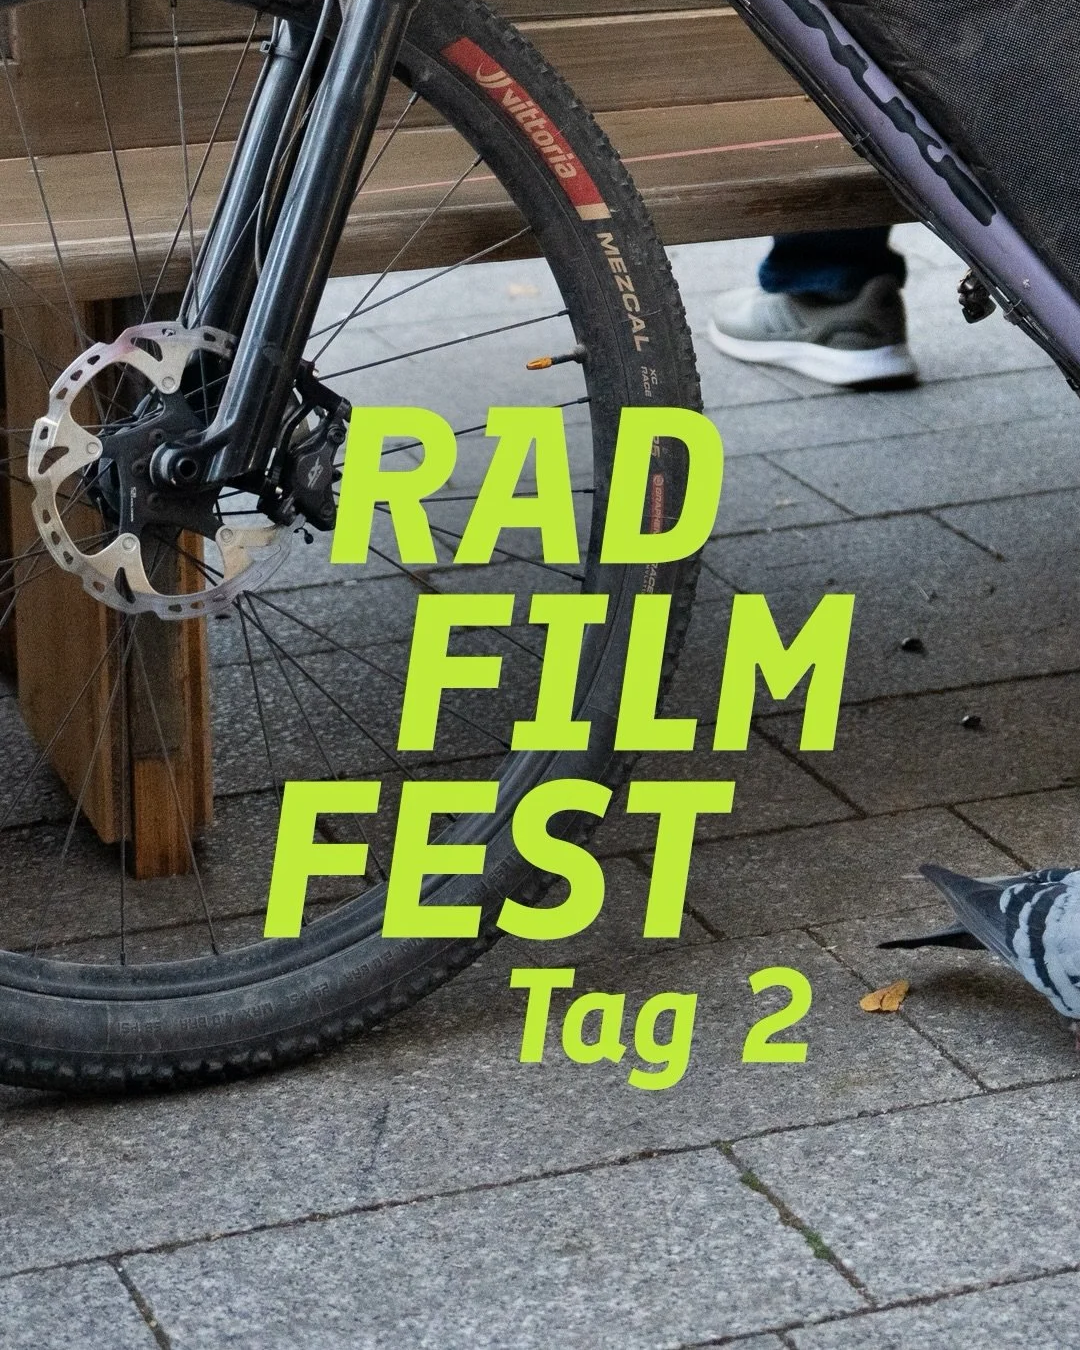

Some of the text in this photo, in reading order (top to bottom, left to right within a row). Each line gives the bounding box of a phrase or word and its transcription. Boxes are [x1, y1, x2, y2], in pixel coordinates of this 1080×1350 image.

[502, 86, 577, 178] vittoria
[596, 232, 652, 352] MEZCAL
[640, 365, 651, 397] RACE
[648, 367, 658, 385] XC
[652, 488, 662, 534] GRAPHEN
